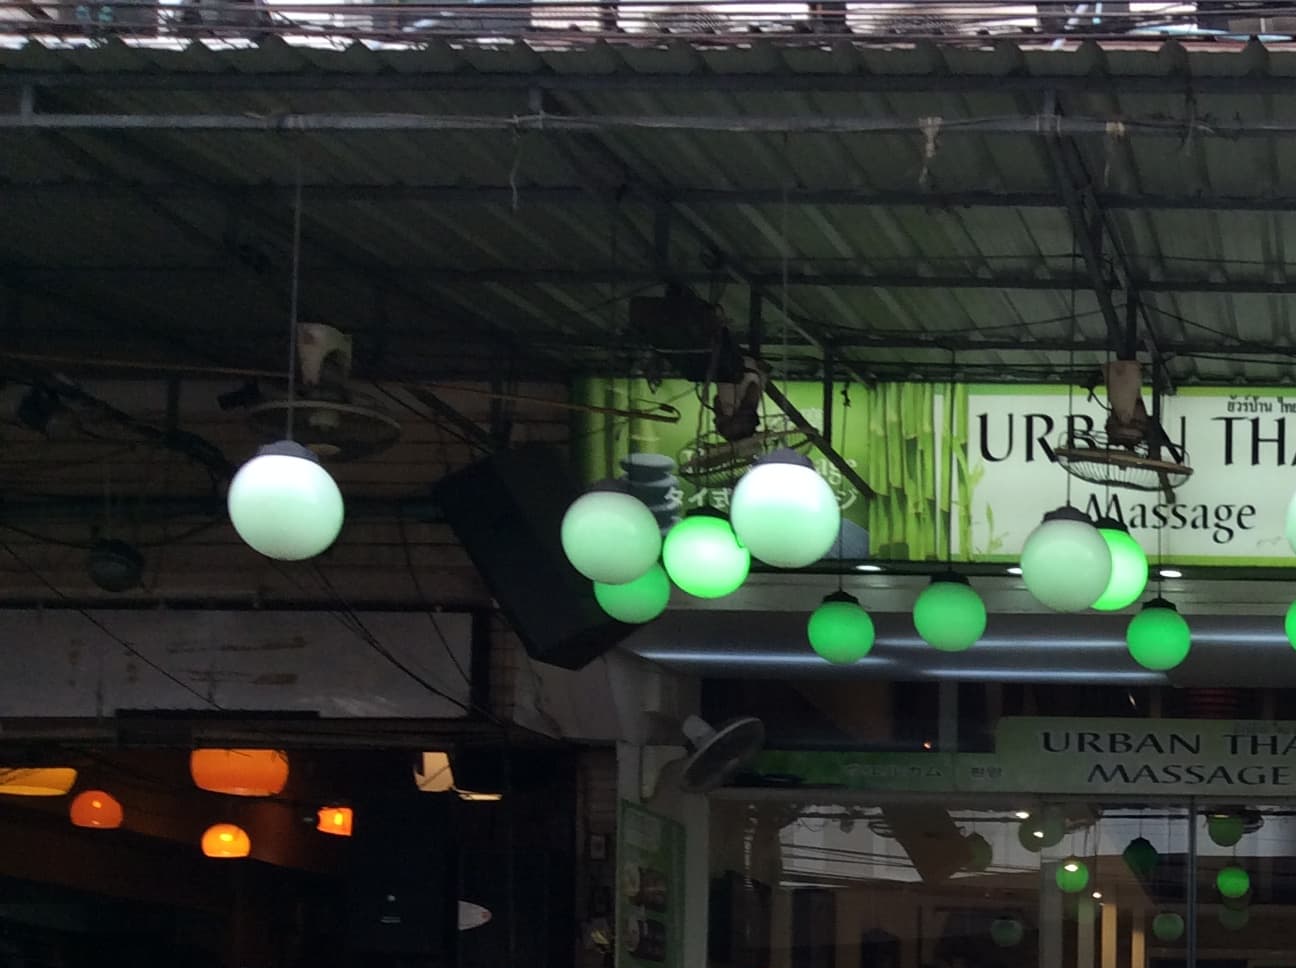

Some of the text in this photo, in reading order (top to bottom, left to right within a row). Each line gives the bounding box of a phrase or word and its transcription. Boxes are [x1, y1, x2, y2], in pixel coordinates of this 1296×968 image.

[1085, 493, 1257, 544] Massage
[1040, 731, 1200, 756] URBAN
[1087, 763, 1293, 786] MASSAGE
